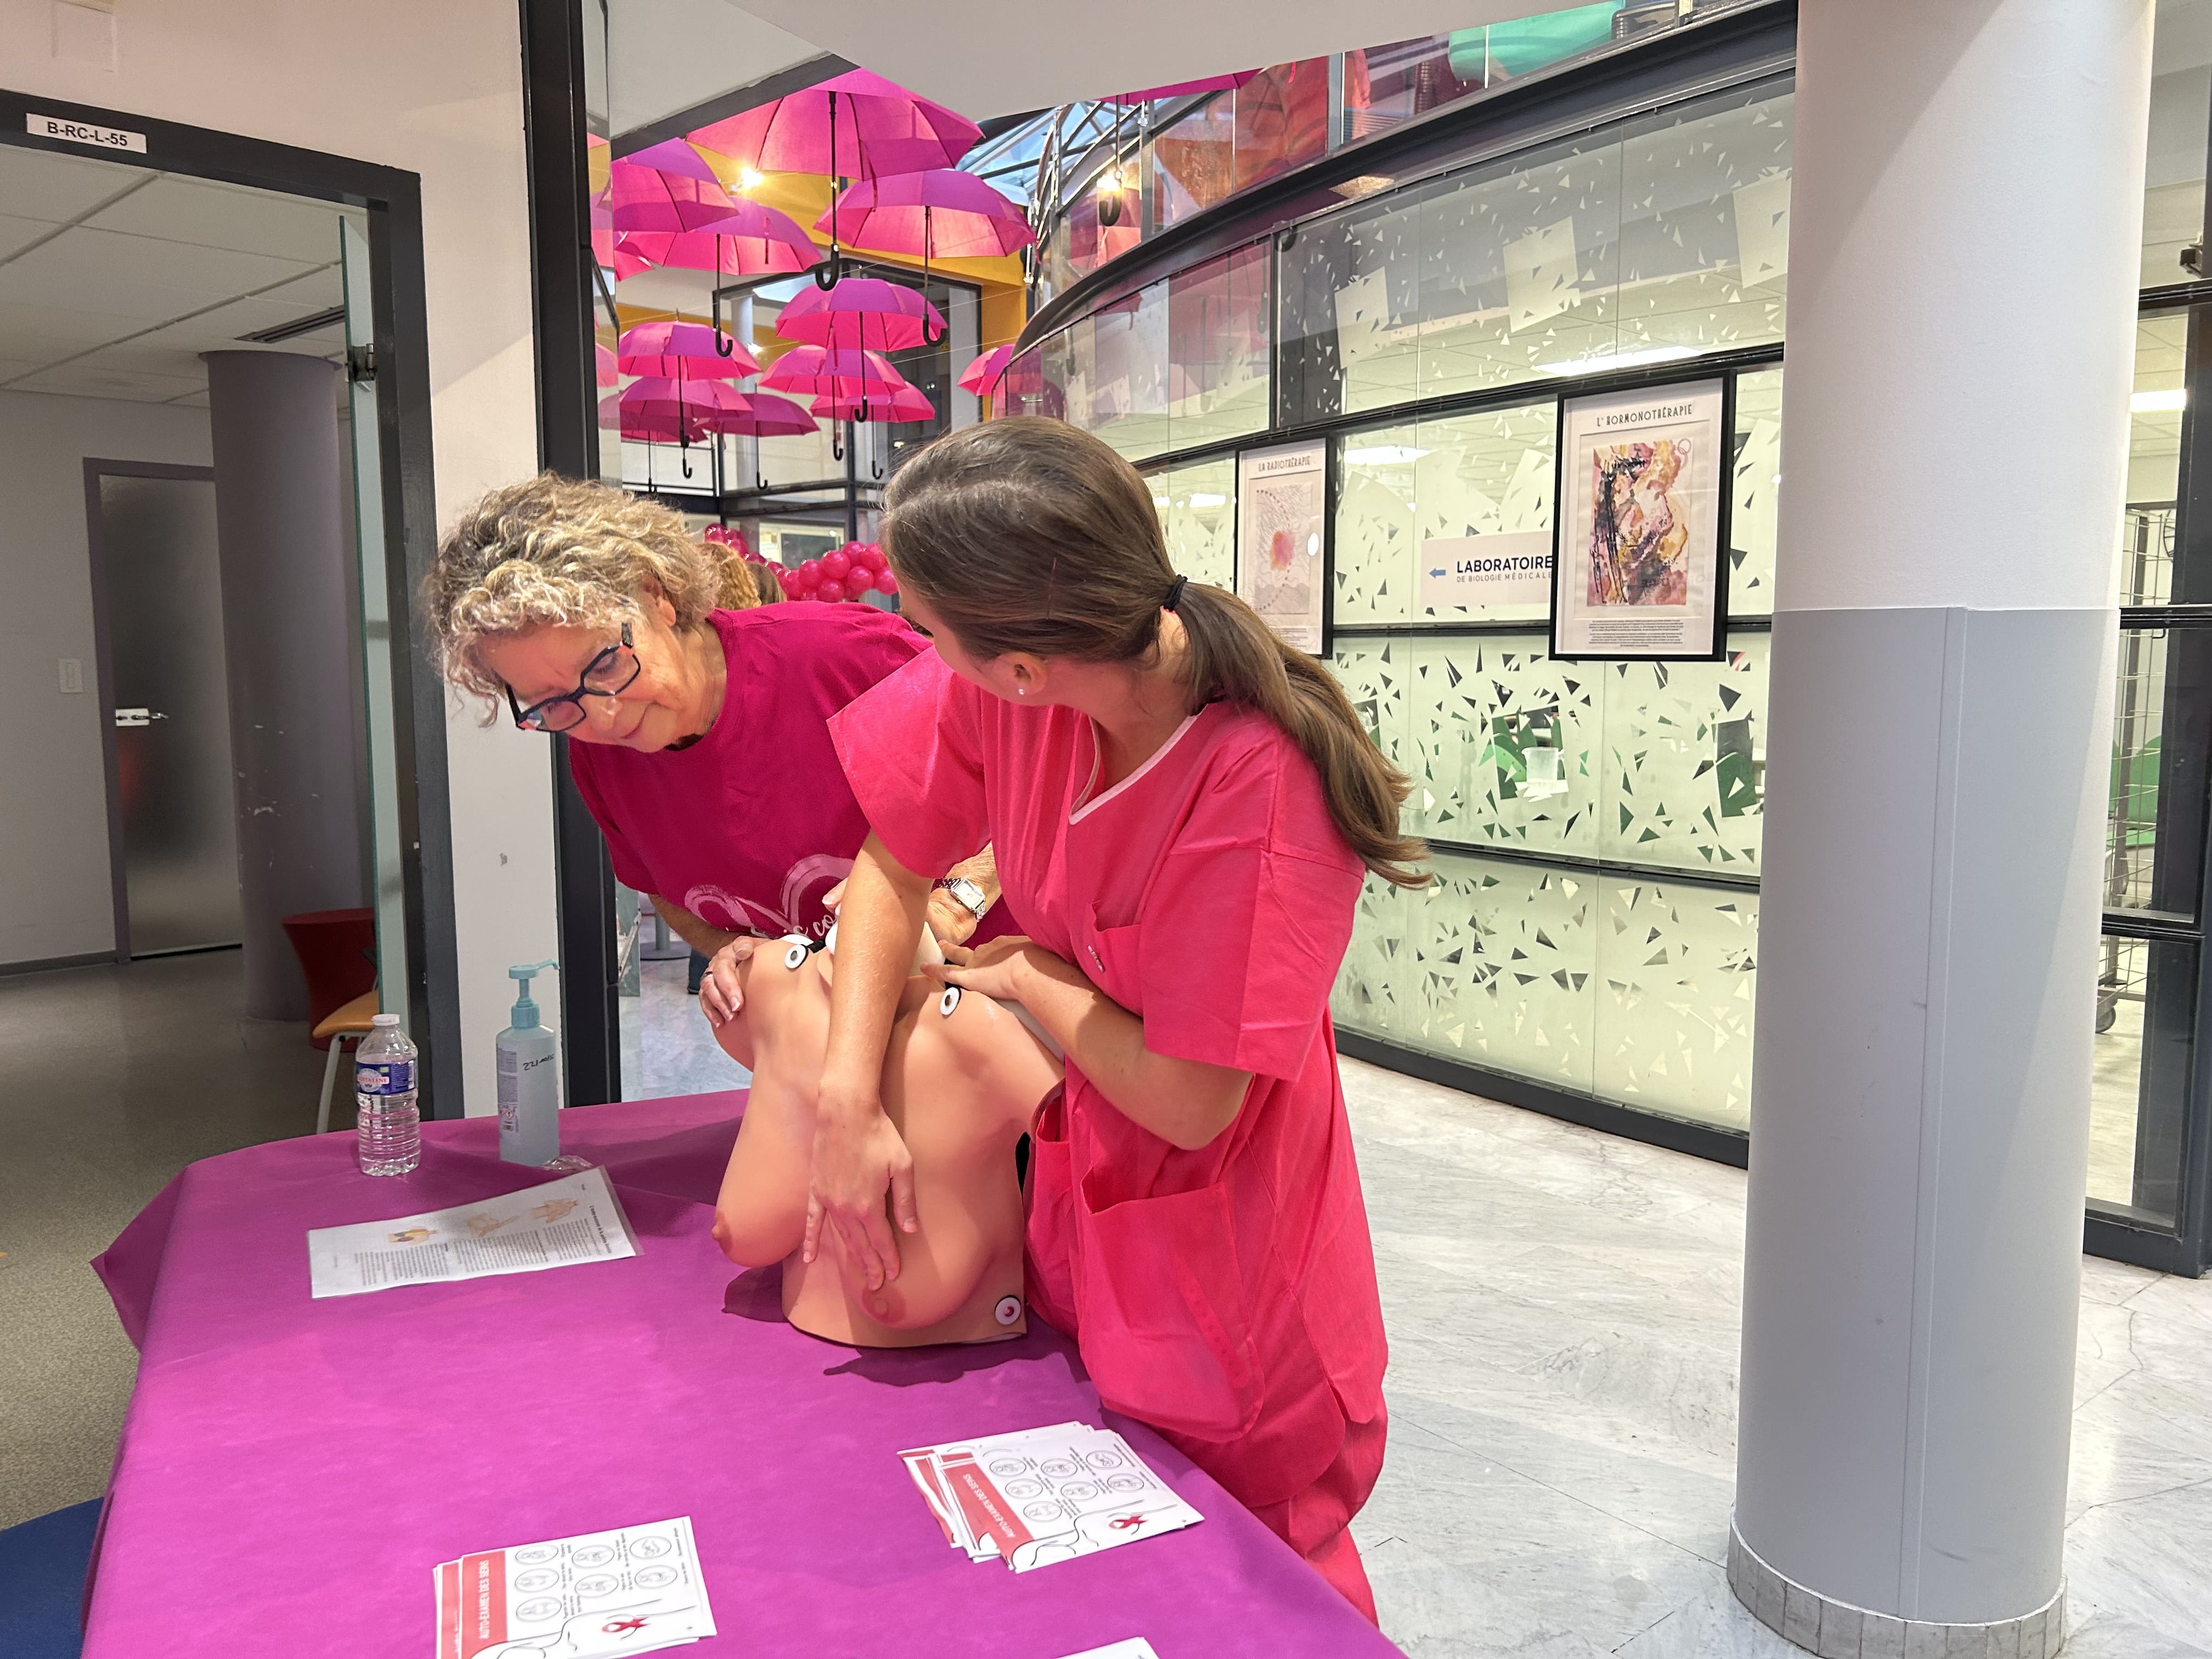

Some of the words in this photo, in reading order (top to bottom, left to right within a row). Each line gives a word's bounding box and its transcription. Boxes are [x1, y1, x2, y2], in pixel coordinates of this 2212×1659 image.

[47, 121, 128, 146] B-RC-L-55
[1457, 555, 1553, 573] LABORATOIRE
[1468, 574, 1502, 582] BIOLOGIE
[1504, 572, 1553, 580] MÉDICALE
